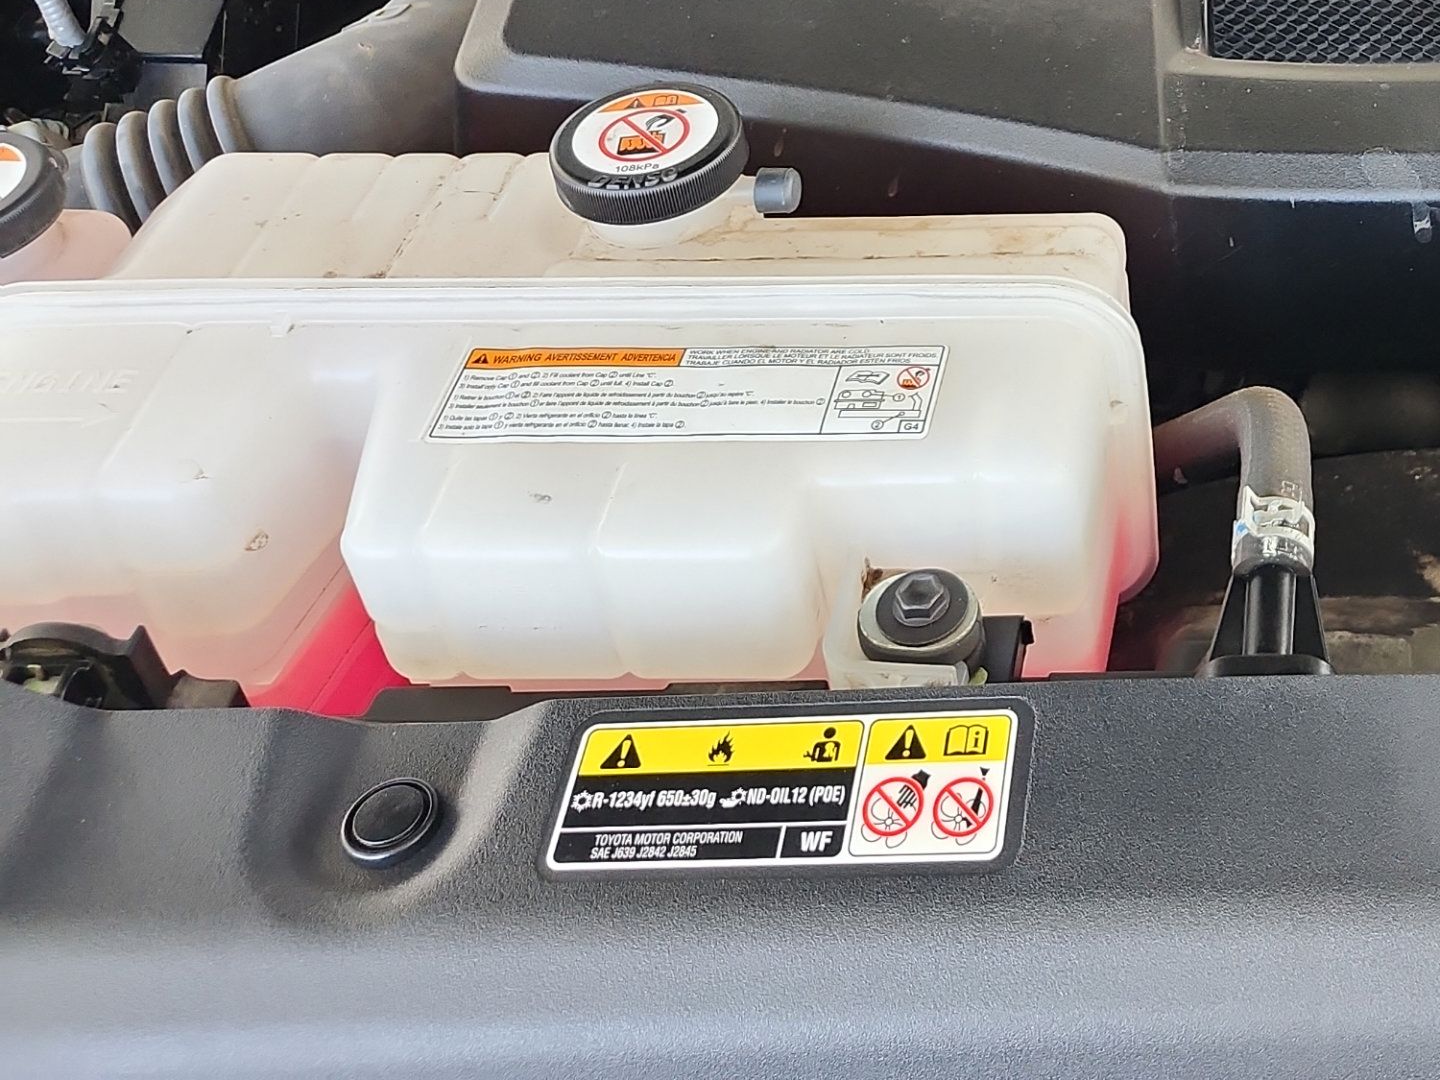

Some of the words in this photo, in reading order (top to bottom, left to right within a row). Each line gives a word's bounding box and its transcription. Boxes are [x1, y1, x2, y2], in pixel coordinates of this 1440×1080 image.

[615, 163, 660, 173] 108kPa
[587, 168, 679, 190] DENSO
[493, 353, 542, 364] WARNING
[545, 352, 619, 362] AVERTISSEMENT
[620, 353, 676, 362] ADVERTENCIA
[592, 790, 656, 811] R-1234yf
[656, 789, 716, 809] 650±30g
[808, 785, 846, 807] (POE)
[595, 833, 632, 846] TOYOTA
[634, 832, 672, 846] MOTOR
[672, 830, 744, 844] CORPORATION
[800, 830, 834, 852] WF
[590, 846, 610, 860] SAE
[611, 846, 636, 860] J639
[636, 846, 668, 859] J2842
[667, 845, 698, 858] J2845
